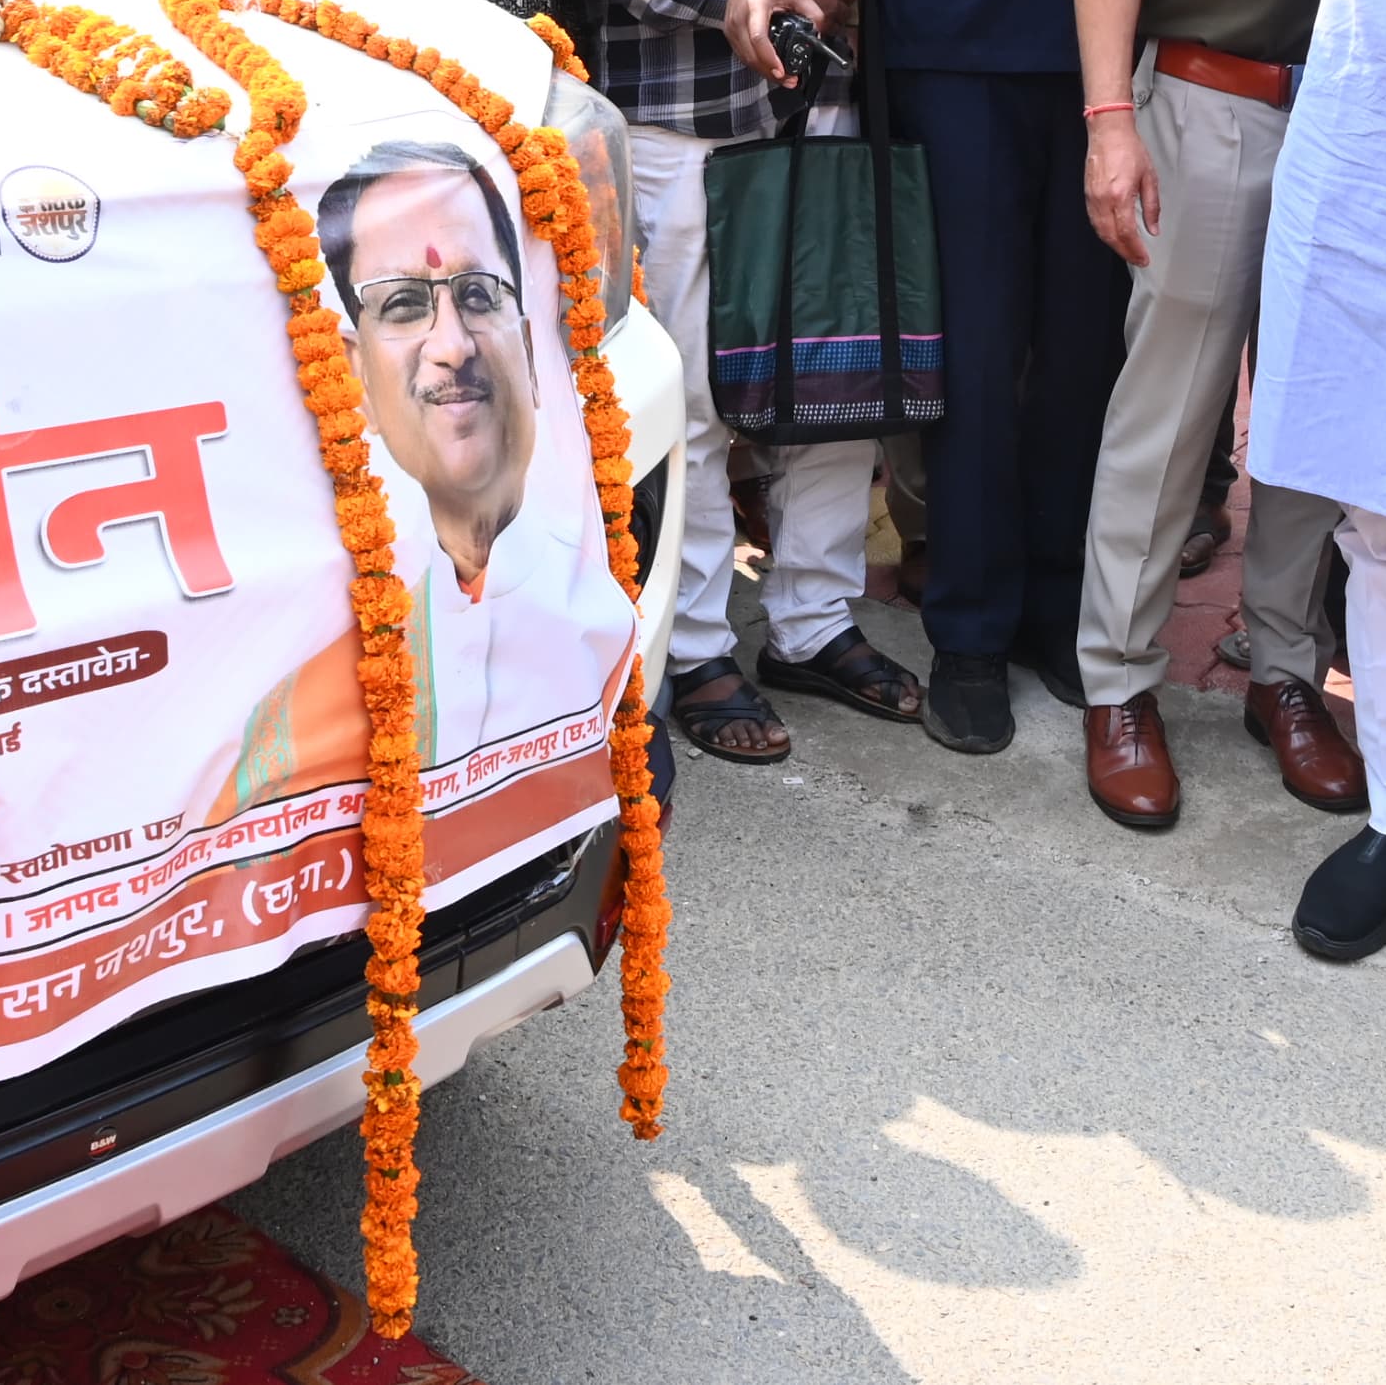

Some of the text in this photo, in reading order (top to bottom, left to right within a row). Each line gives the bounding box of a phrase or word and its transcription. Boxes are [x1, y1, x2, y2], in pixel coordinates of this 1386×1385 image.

[142, 810, 186, 843] पत्र
[25, 883, 121, 933] जनपद
[240, 847, 355, 927] (छ.ग.)
